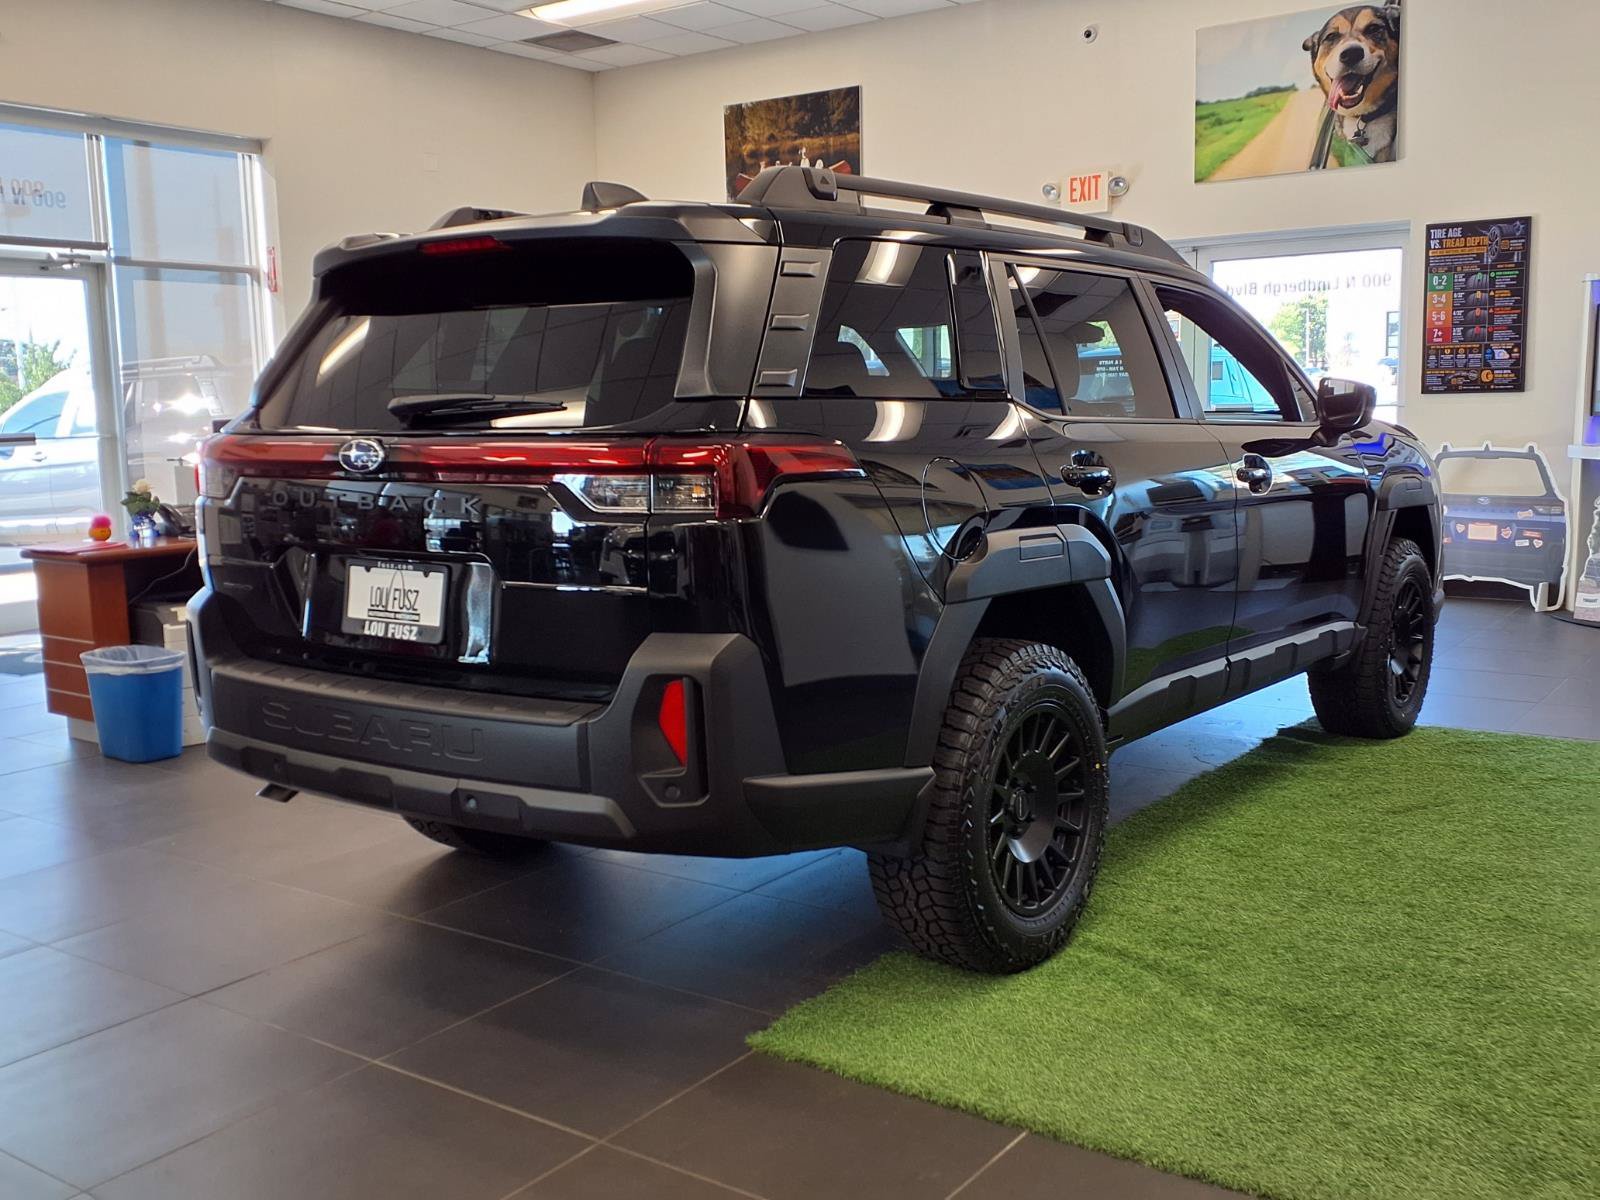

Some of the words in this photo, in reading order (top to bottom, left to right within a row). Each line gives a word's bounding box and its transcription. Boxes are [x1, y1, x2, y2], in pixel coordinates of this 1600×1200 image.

[1070, 175, 1101, 202] EXIT
[1430, 229, 1447, 239] TIRE
[1448, 227, 1462, 238] AGE
[1430, 239, 1441, 249] VS.
[1442, 238, 1465, 248] TREAD
[1466, 236, 1488, 247] DEPTH
[1432, 275, 1447, 286] 0-2
[1432, 294, 1446, 304] 3-4
[1431, 311, 1446, 321] 5-6
[1432, 328, 1443, 338] 7+
[273, 490, 481, 515] OUTBACK
[370, 586, 389, 608] LOU
[392, 588, 419, 611] FUSZ
[363, 620, 386, 637] LOU
[387, 623, 419, 641] FUSZ
[262, 701, 484, 762] SUBARU
